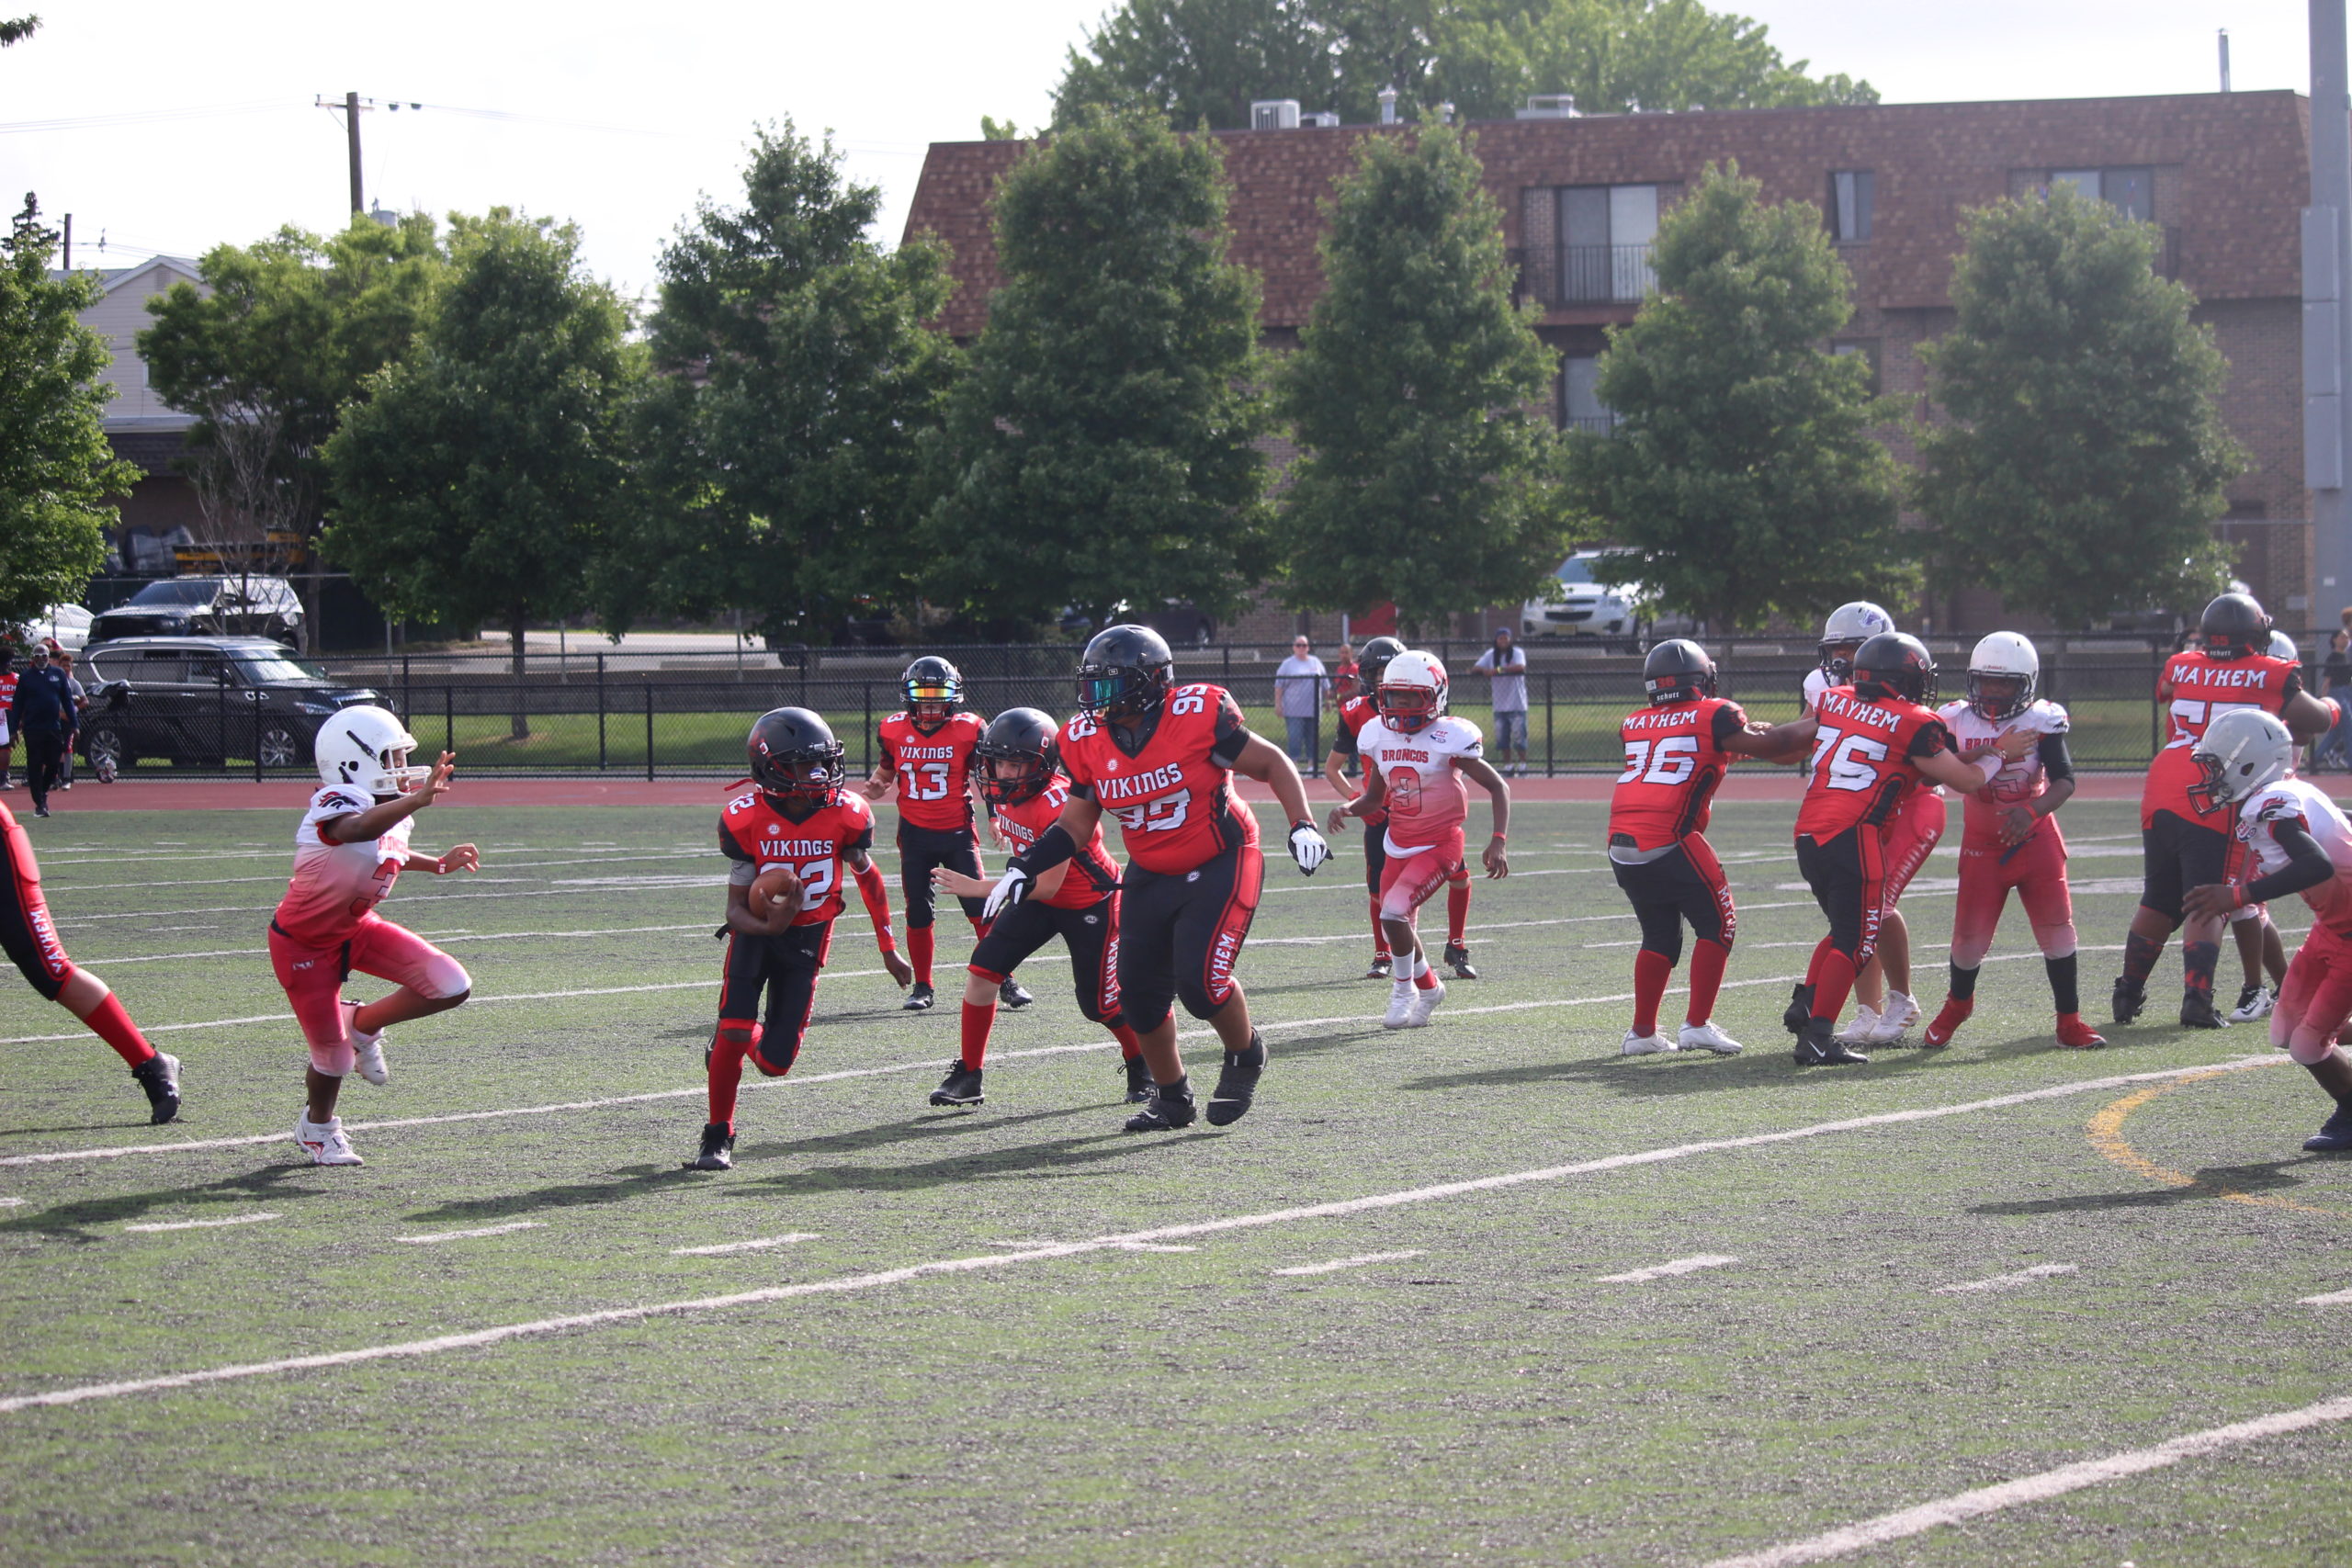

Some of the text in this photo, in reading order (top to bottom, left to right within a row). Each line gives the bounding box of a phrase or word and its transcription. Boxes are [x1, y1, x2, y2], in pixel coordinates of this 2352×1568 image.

[1657, 676, 1677, 689] 36
[2171, 664, 2267, 689] MAYHEM
[1657, 692, 1679, 701] schutt
[1822, 692, 1902, 733] MAYHEM
[1623, 709, 1698, 731] MAYHEM
[2169, 699, 2260, 749] 5
[900, 745, 954, 759] VIKINGS
[1382, 749, 1429, 763] BRONCOS
[1617, 736, 1698, 785] 36
[1808, 725, 1888, 792] 76
[900, 762, 949, 801] 13
[1097, 762, 1183, 800] VIKINGS
[1388, 766, 1421, 818] 9
[996, 812, 1035, 842] VIKINGS
[1110, 788, 1192, 832] 99
[759, 840, 834, 857] VIKINGS
[30, 909, 63, 974] MAYHEM
[1104, 935, 1120, 1005] MAYHEM
